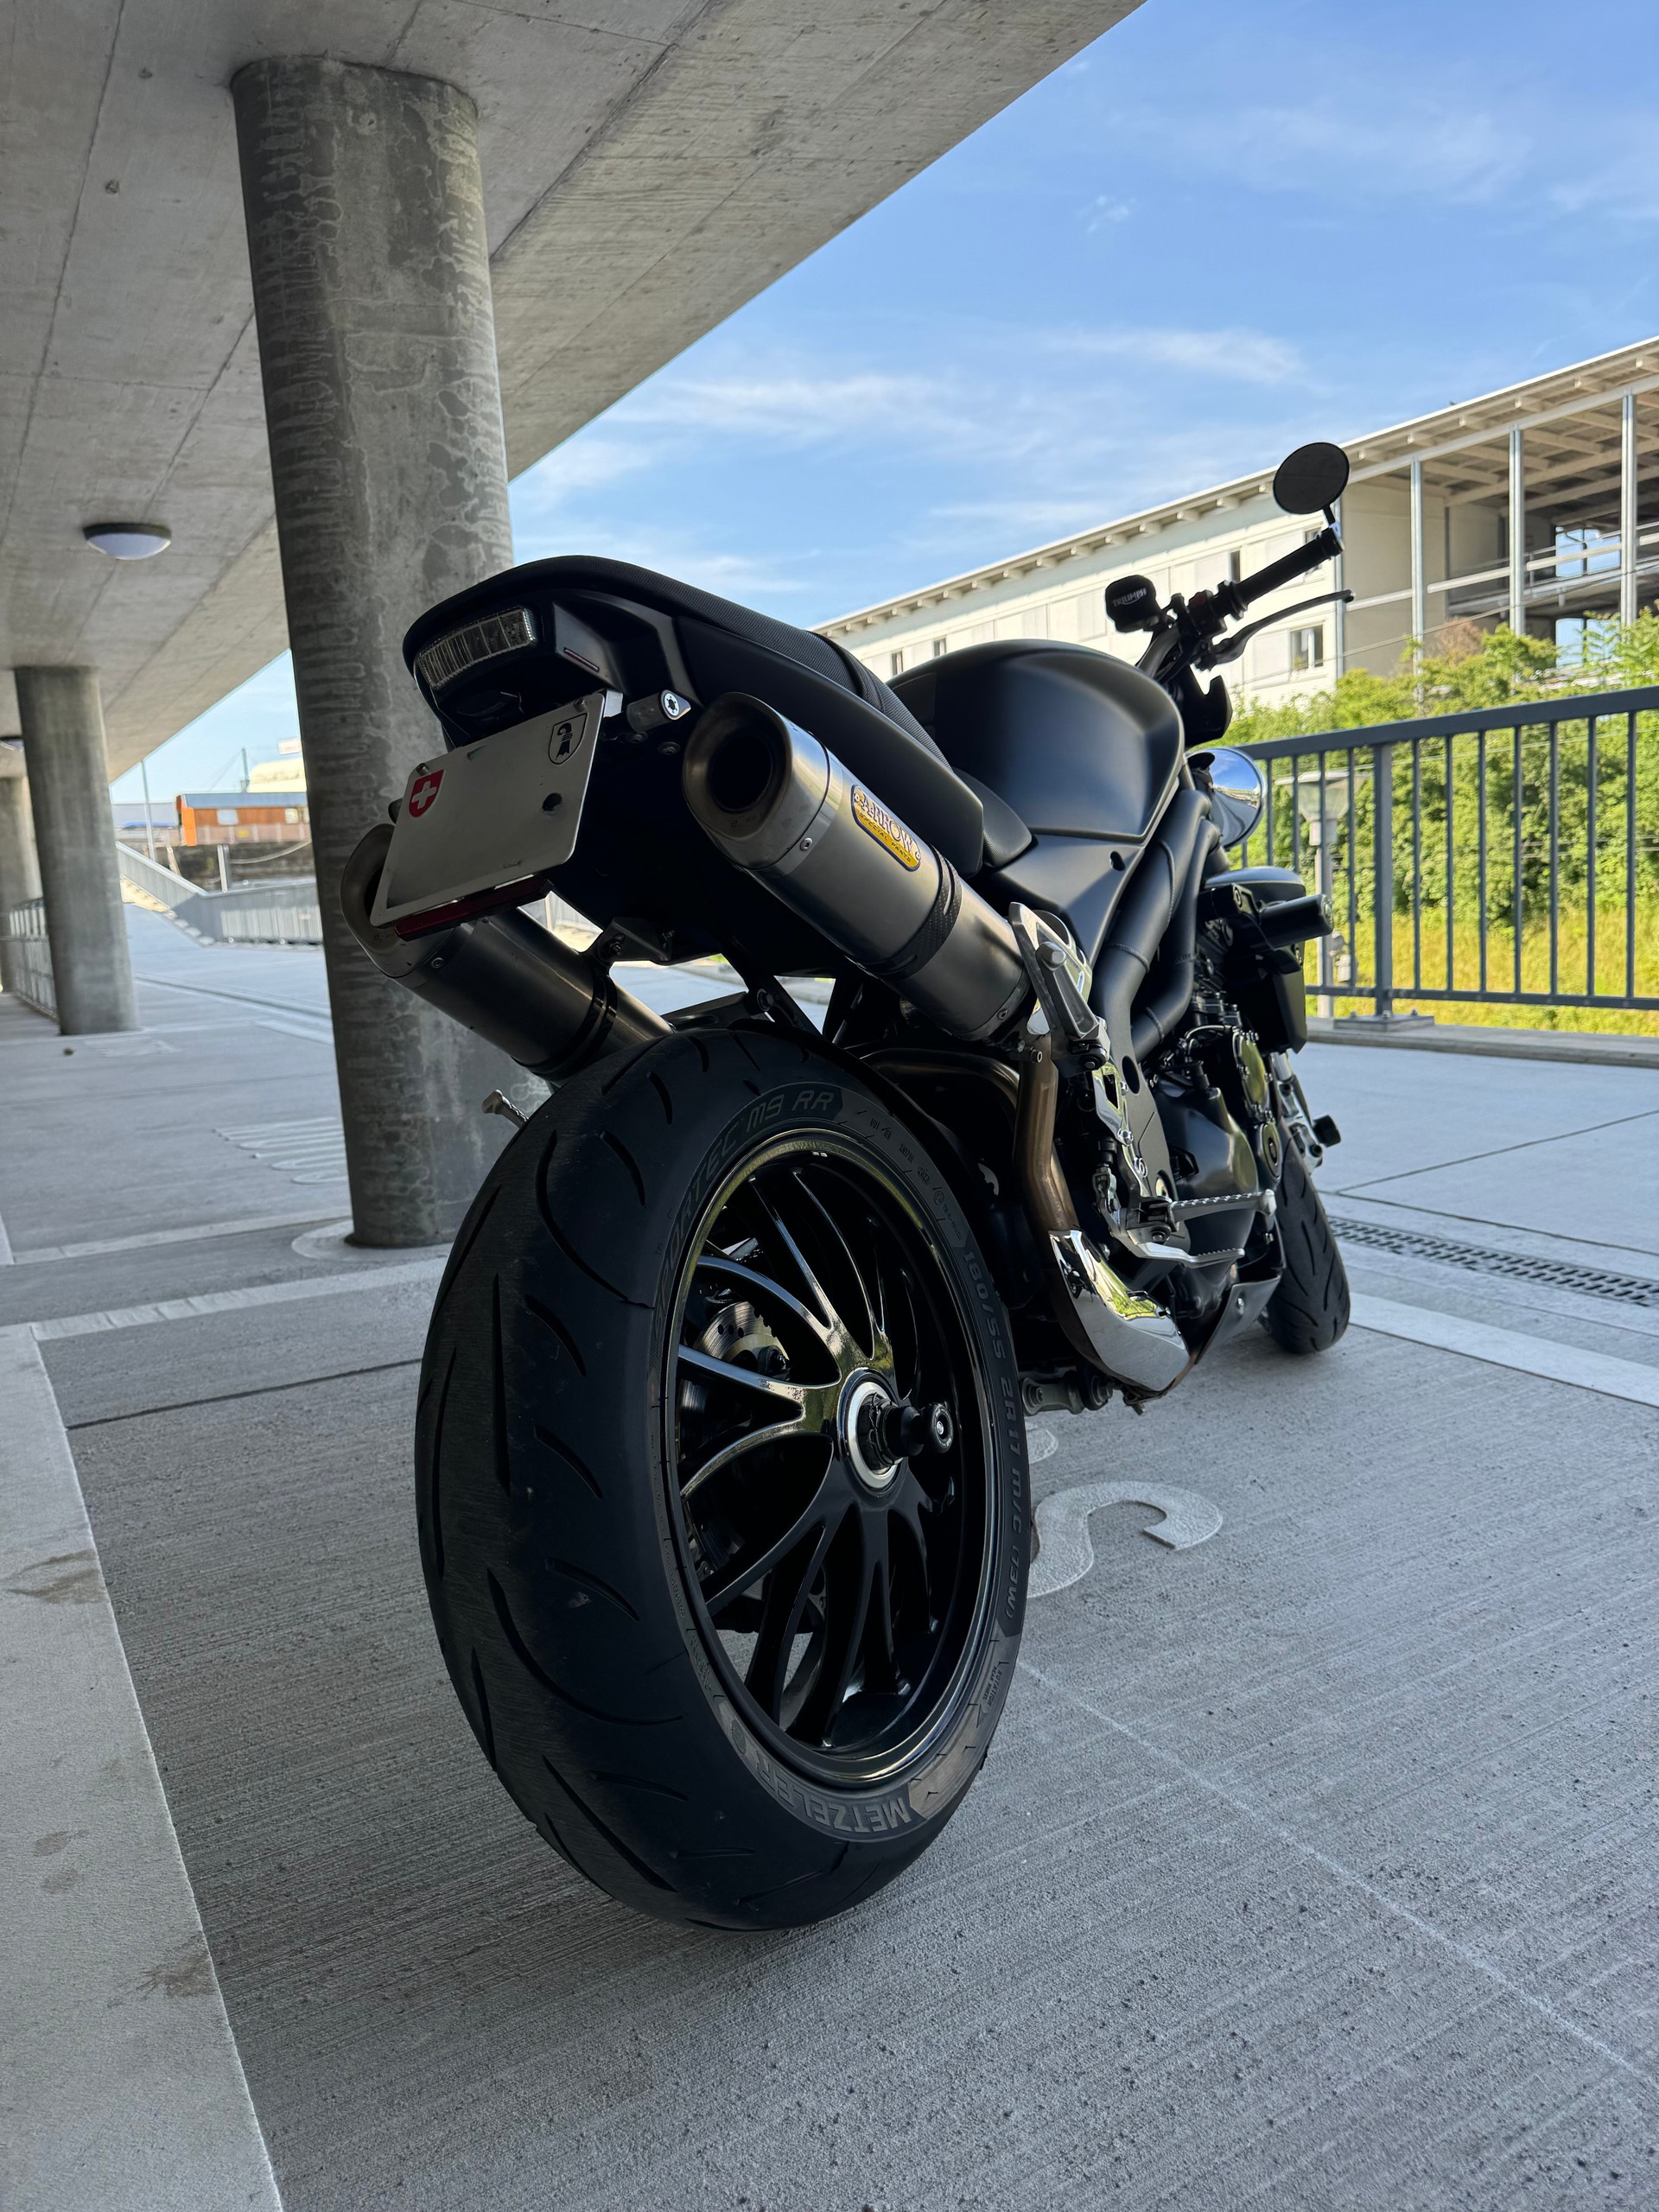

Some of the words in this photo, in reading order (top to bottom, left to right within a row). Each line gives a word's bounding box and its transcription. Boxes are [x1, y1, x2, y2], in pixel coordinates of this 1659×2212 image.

[1111, 588, 1147, 607] TRIUMPH
[859, 811, 889, 841] SPECIAL
[891, 841, 912, 862] PARTS
[861, 793, 916, 854] ARROW
[746, 1094, 783, 1134] M9
[791, 1089, 835, 1112] RR
[963, 1251, 1007, 1358] 180/55
[1010, 1467, 1022, 1535] M/C
[1004, 1544, 1020, 1620] (73W)
[754, 1749, 912, 1833] METZELER
